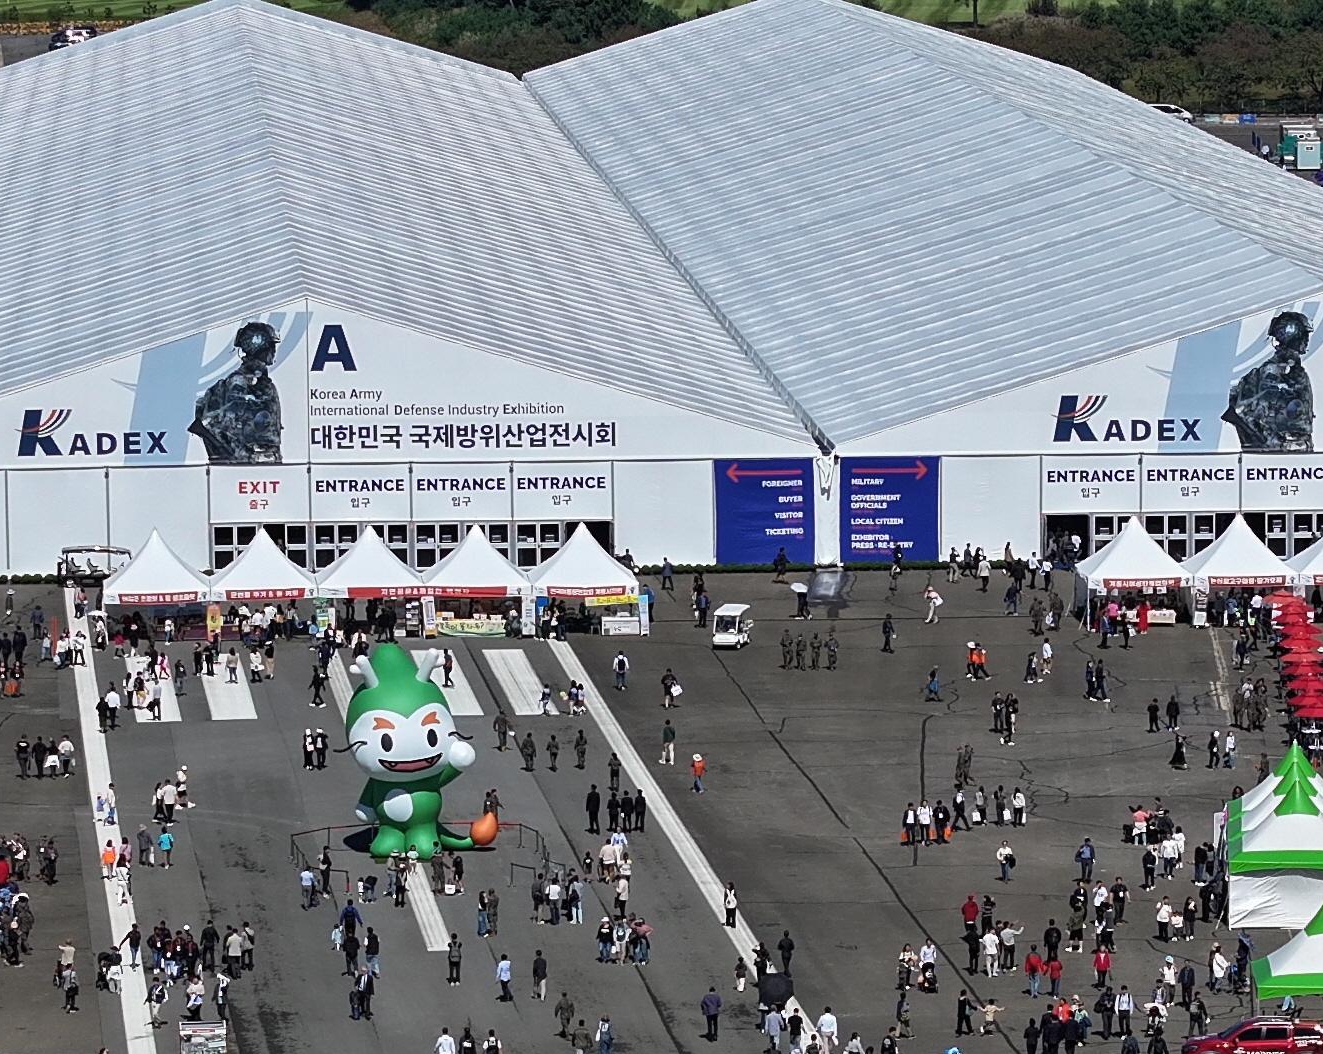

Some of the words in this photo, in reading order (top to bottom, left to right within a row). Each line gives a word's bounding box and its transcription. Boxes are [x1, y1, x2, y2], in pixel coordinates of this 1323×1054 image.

[310, 324, 358, 371] A
[310, 389, 346, 400] Korea
[349, 388, 383, 401] Army
[310, 404, 389, 417] International
[394, 404, 445, 416] Defense
[448, 403, 500, 418] Industry
[503, 402, 565, 415] Exhibition
[1051, 395, 1201, 442] KADEX
[14, 409, 169, 457] KADEX
[310, 425, 403, 450] 대한민국
[409, 421, 617, 449] 국제방위산업전시회
[1047, 469, 1135, 483] ENTRANCE
[1146, 468, 1235, 482] ENTRANCE
[238, 481, 280, 494] EXIT
[315, 479, 405, 493] ENTRANCE
[416, 477, 506, 492] ENTRANCE
[517, 476, 606, 490] ENTRANCE
[762, 479, 803, 487] FOREIGNER
[851, 478, 885, 486] MILITARY
[1080, 487, 1101, 498] 입구
[1180, 486, 1200, 497] 입구
[1279, 485, 1300, 496] 입구
[249, 499, 269, 509] 출구
[350, 497, 370, 508] 입구
[451, 496, 472, 507] 입구
[551, 494, 572, 506] 입구
[778, 495, 803, 503] BUYER
[774, 511, 803, 519] VISITOR
[875, 517, 904, 525] CITIZEN
[765, 527, 804, 535] TICKETING
[877, 541, 914, 549] RE-ETRY
